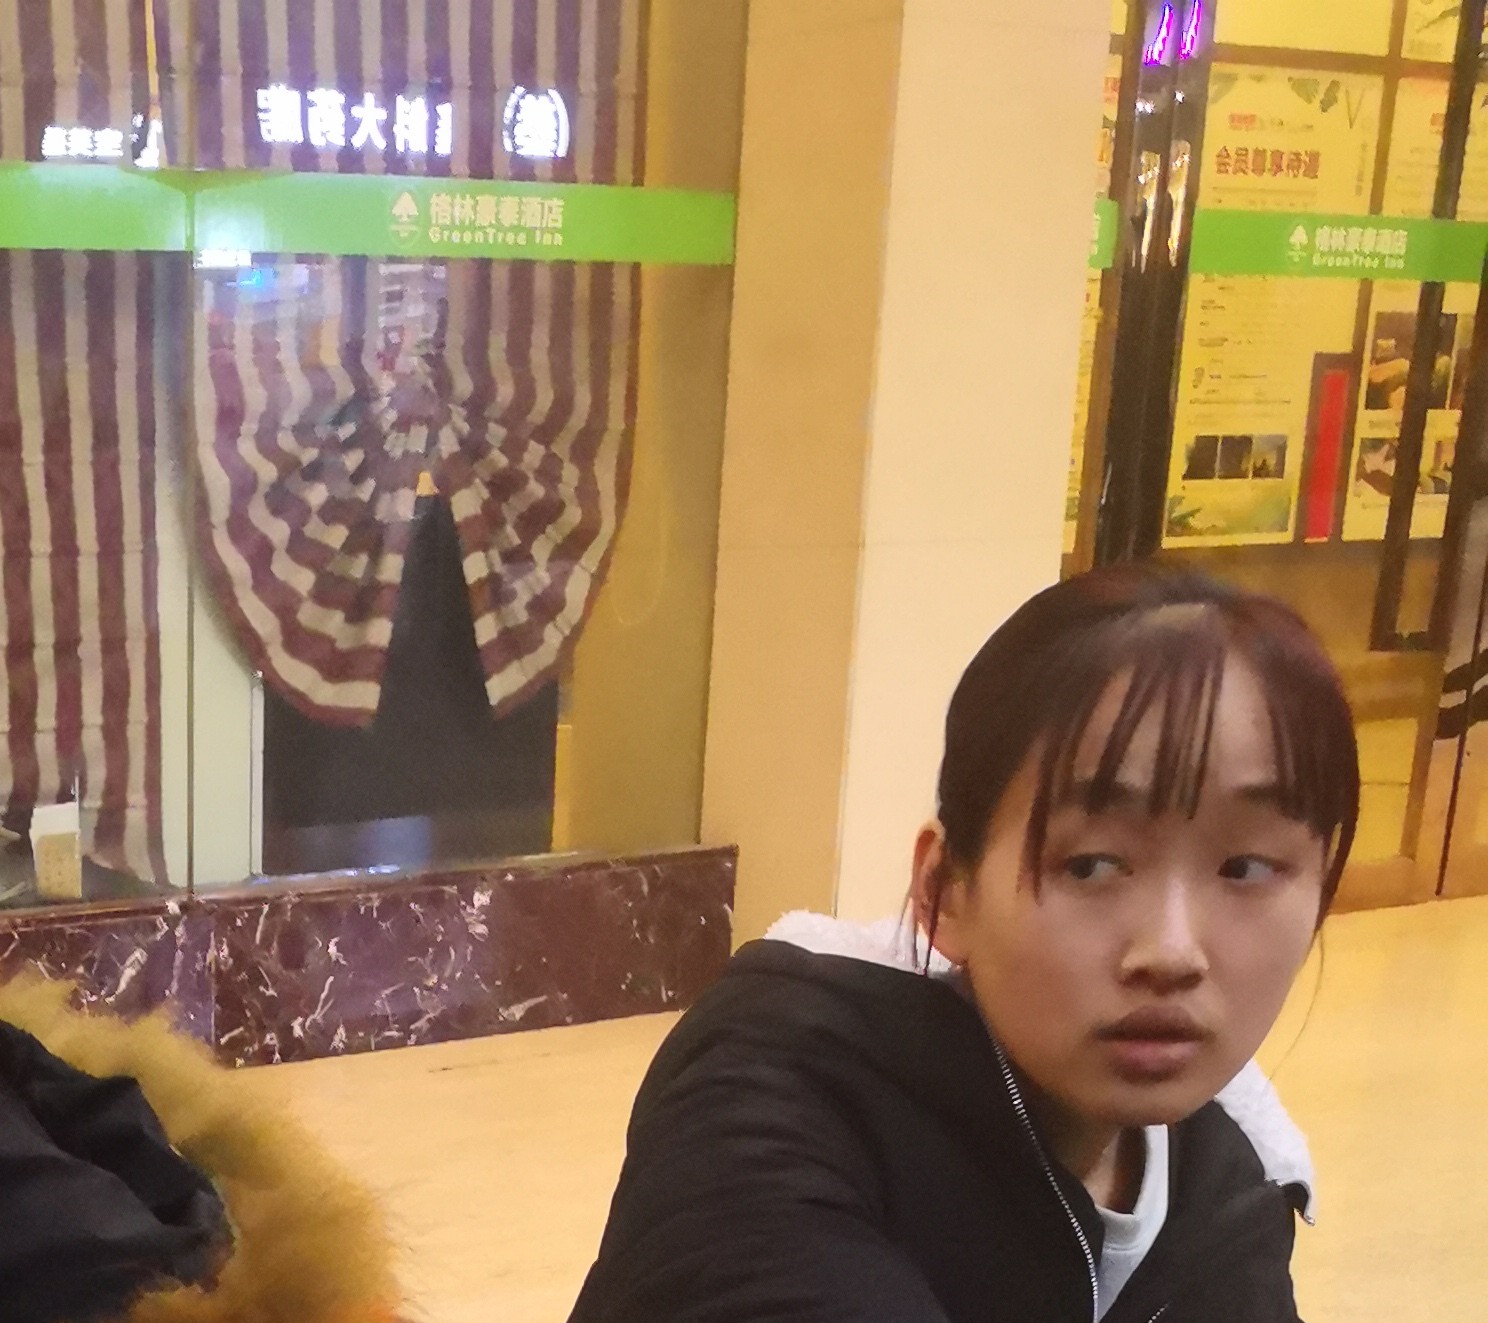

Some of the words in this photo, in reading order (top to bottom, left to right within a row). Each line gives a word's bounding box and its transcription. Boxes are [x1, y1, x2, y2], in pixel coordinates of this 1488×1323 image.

[430, 193, 565, 229] 格林豪泰酒店
[428, 226, 527, 246] GreenTree
[534, 229, 563, 246] Inn
